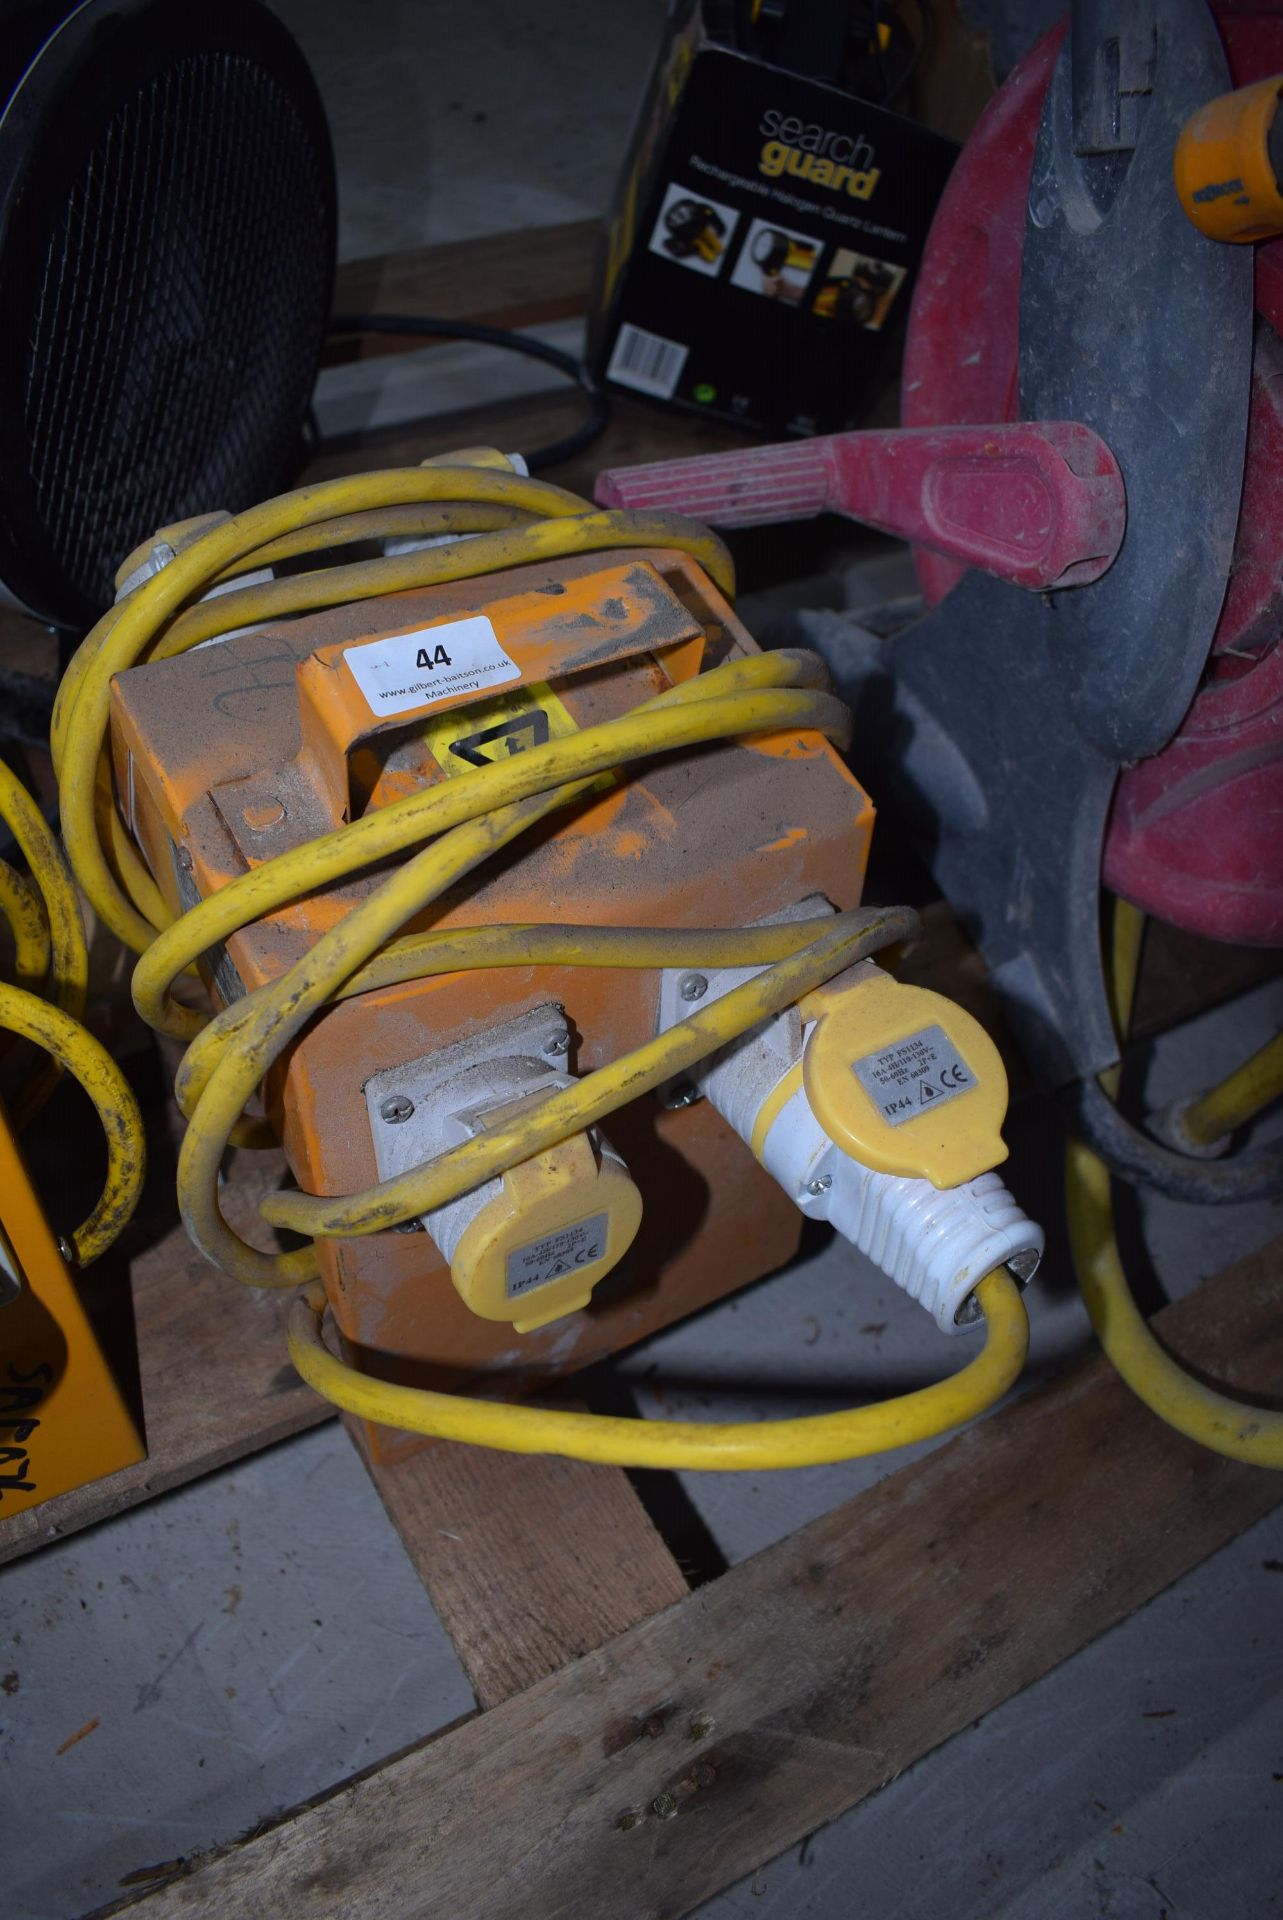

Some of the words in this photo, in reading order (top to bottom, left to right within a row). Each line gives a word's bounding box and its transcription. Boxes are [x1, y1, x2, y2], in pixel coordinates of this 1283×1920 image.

[760, 109, 875, 170] search
[758, 141, 881, 201] guard
[416, 645, 451, 670] 44
[379, 660, 511, 699] www.gilbert-baitson.co.uk
[425, 680, 479, 700] Machinery
[877, 1053, 894, 1065] TYP
[884, 1096, 912, 1115] IP44
[940, 1064, 968, 1088] CE
[897, 1075, 909, 1086] EN
[512, 1274, 538, 1291] IP44
[575, 1243, 598, 1263] CE
